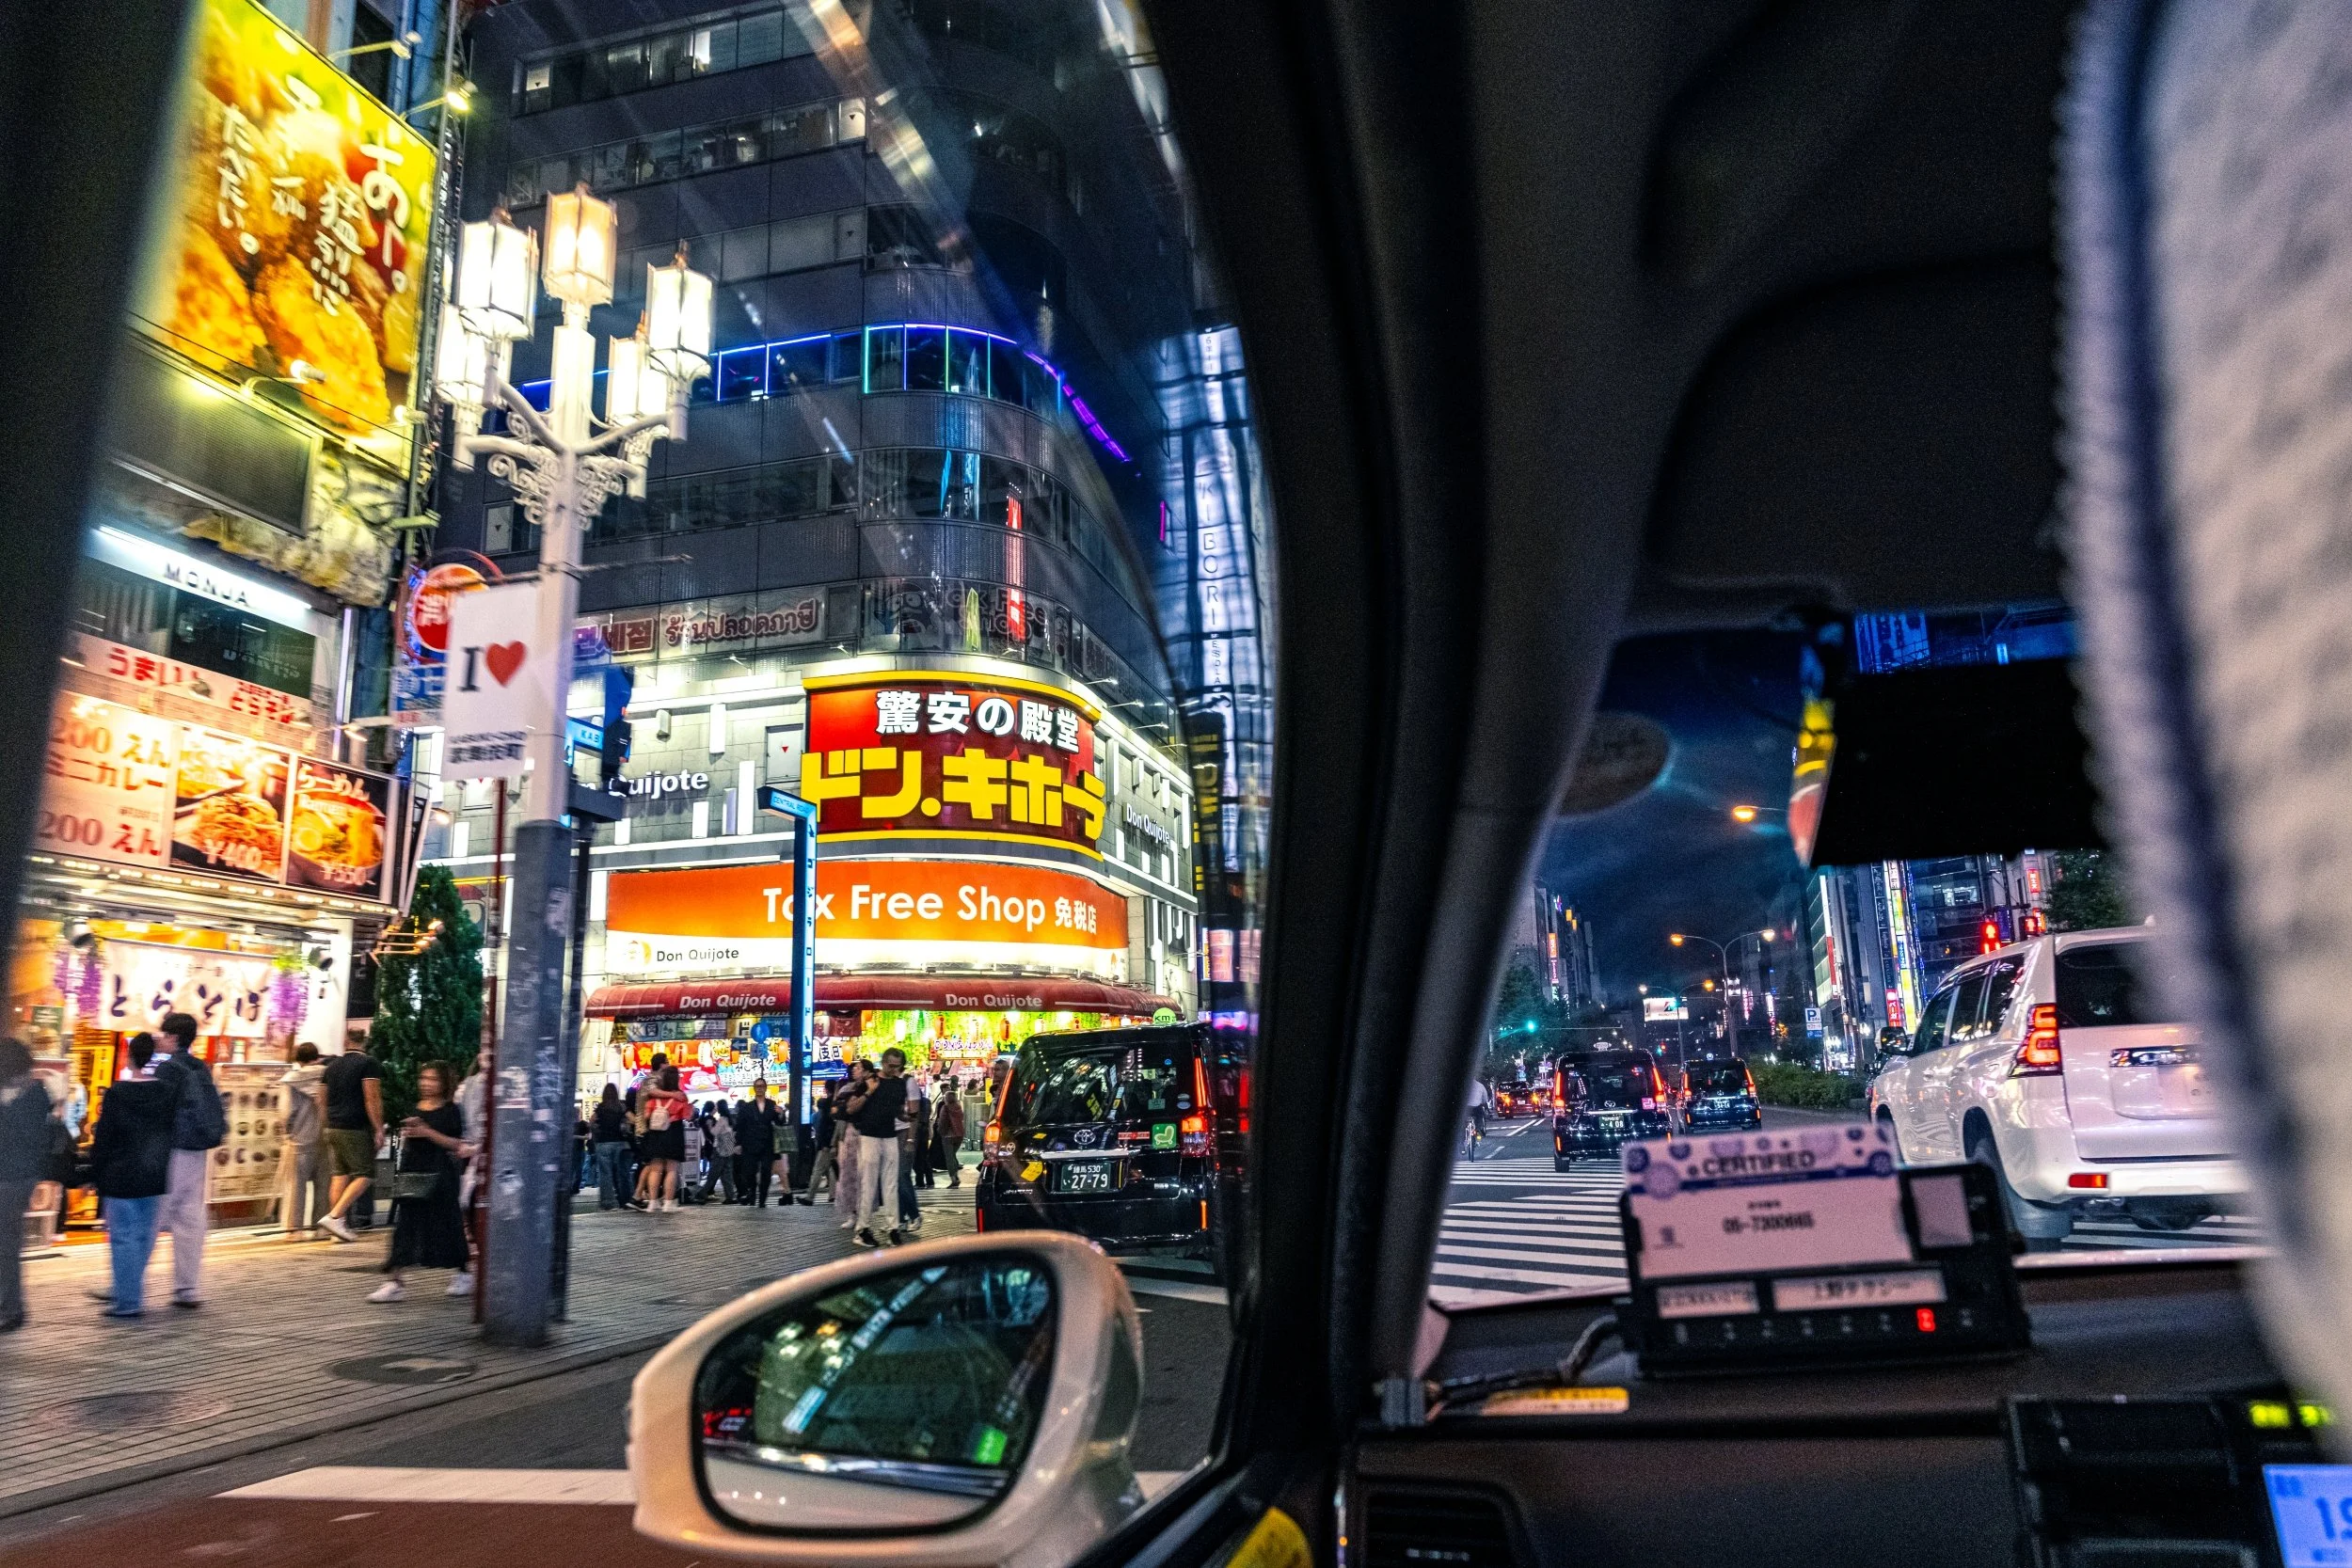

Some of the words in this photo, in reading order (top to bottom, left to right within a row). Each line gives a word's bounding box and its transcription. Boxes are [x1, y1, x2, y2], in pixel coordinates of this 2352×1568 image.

[164, 562, 250, 607] MONJA
[875, 689, 1081, 754] 驚安の殿堂
[1126, 802, 1142, 830] Don
[1143, 814, 1170, 845] Quijote
[110, 823, 162, 856] えん
[850, 883, 944, 921] Free
[957, 884, 1046, 932] Shop
[1054, 895, 1098, 936] 免税店
[656, 949, 683, 962] Don
[689, 946, 740, 963] Quijote
[679, 995, 711, 1009] Don
[717, 993, 776, 1012] Quijote
[945, 993, 979, 1007] Don
[983, 994, 1043, 1010] Quijote
[1806, 1009, 1817, 1022] P
[1071, 1173, 1108, 1190] 27-79
